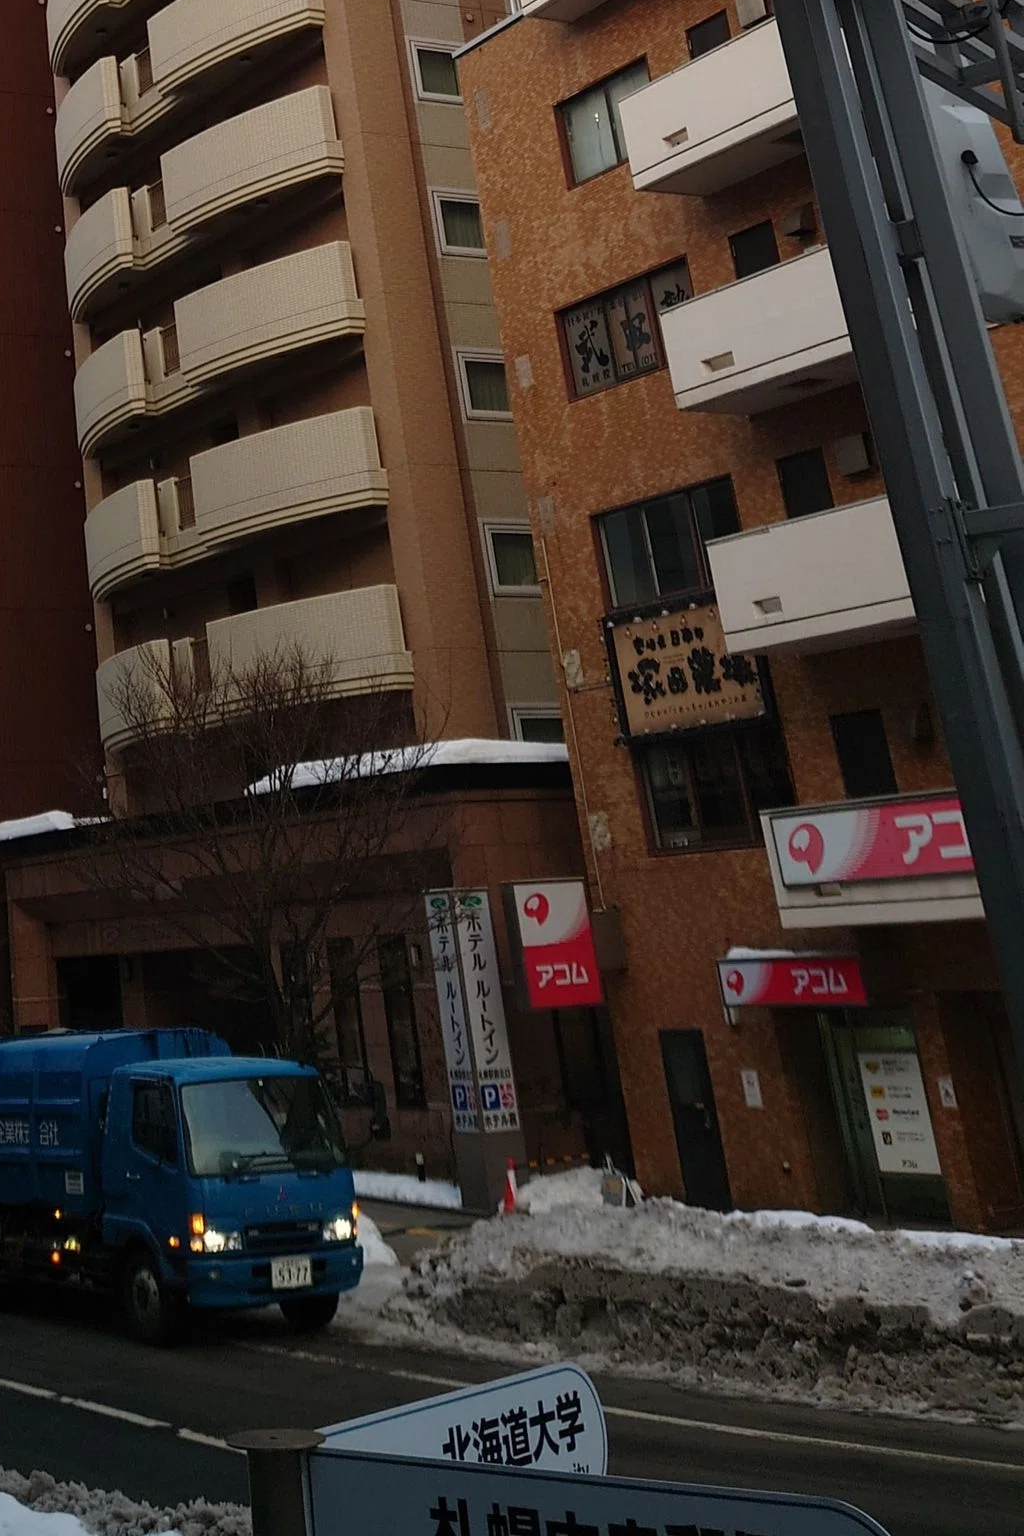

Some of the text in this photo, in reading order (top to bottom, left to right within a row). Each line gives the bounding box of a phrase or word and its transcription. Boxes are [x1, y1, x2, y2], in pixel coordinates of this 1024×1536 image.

[466, 916, 499, 1066] ホテル ルートイン
[535, 964, 589, 989] アコム
[791, 969, 848, 995] アコム
[446, 980, 465, 1066] ルートイン
[442, 1390, 585, 1467] 北海道大学
